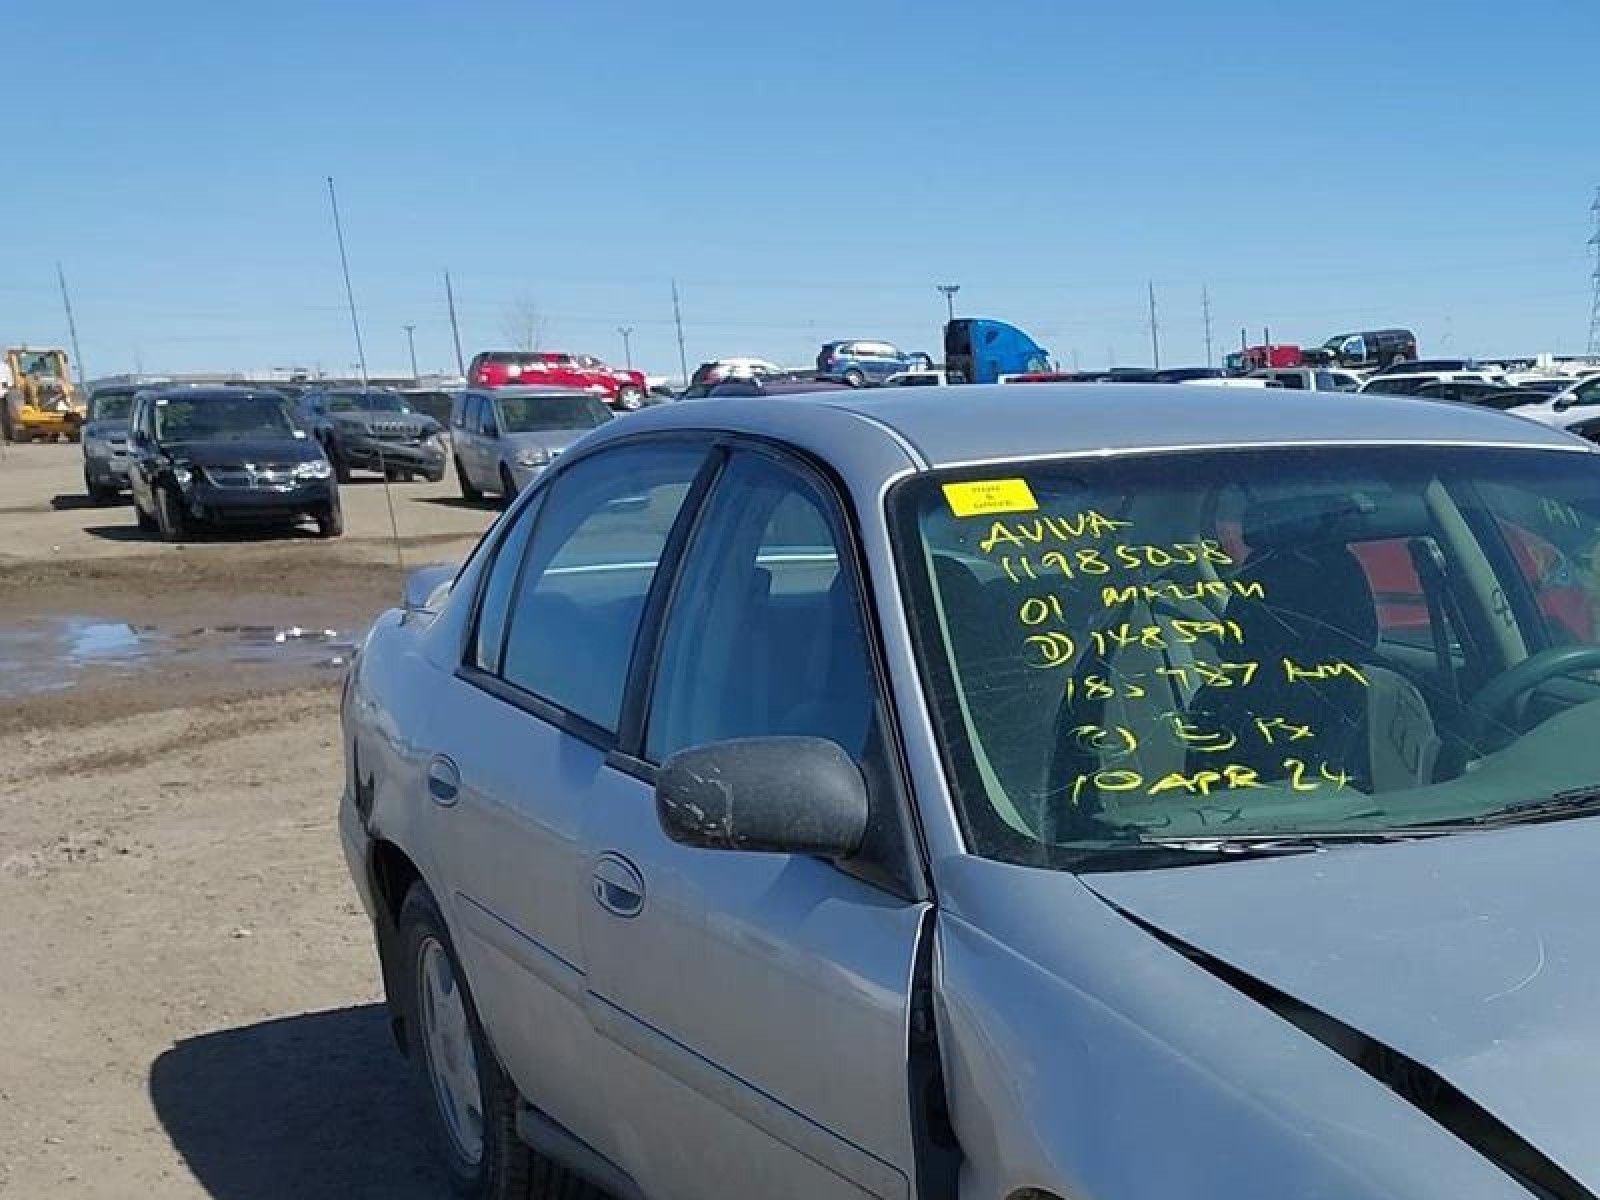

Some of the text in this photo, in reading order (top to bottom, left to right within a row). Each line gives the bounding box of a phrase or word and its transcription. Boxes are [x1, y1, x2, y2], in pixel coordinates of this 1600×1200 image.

[980, 510, 1134, 552] AVIVA
[1001, 539, 1233, 584] 11985058
[1019, 594, 1066, 625] 01
